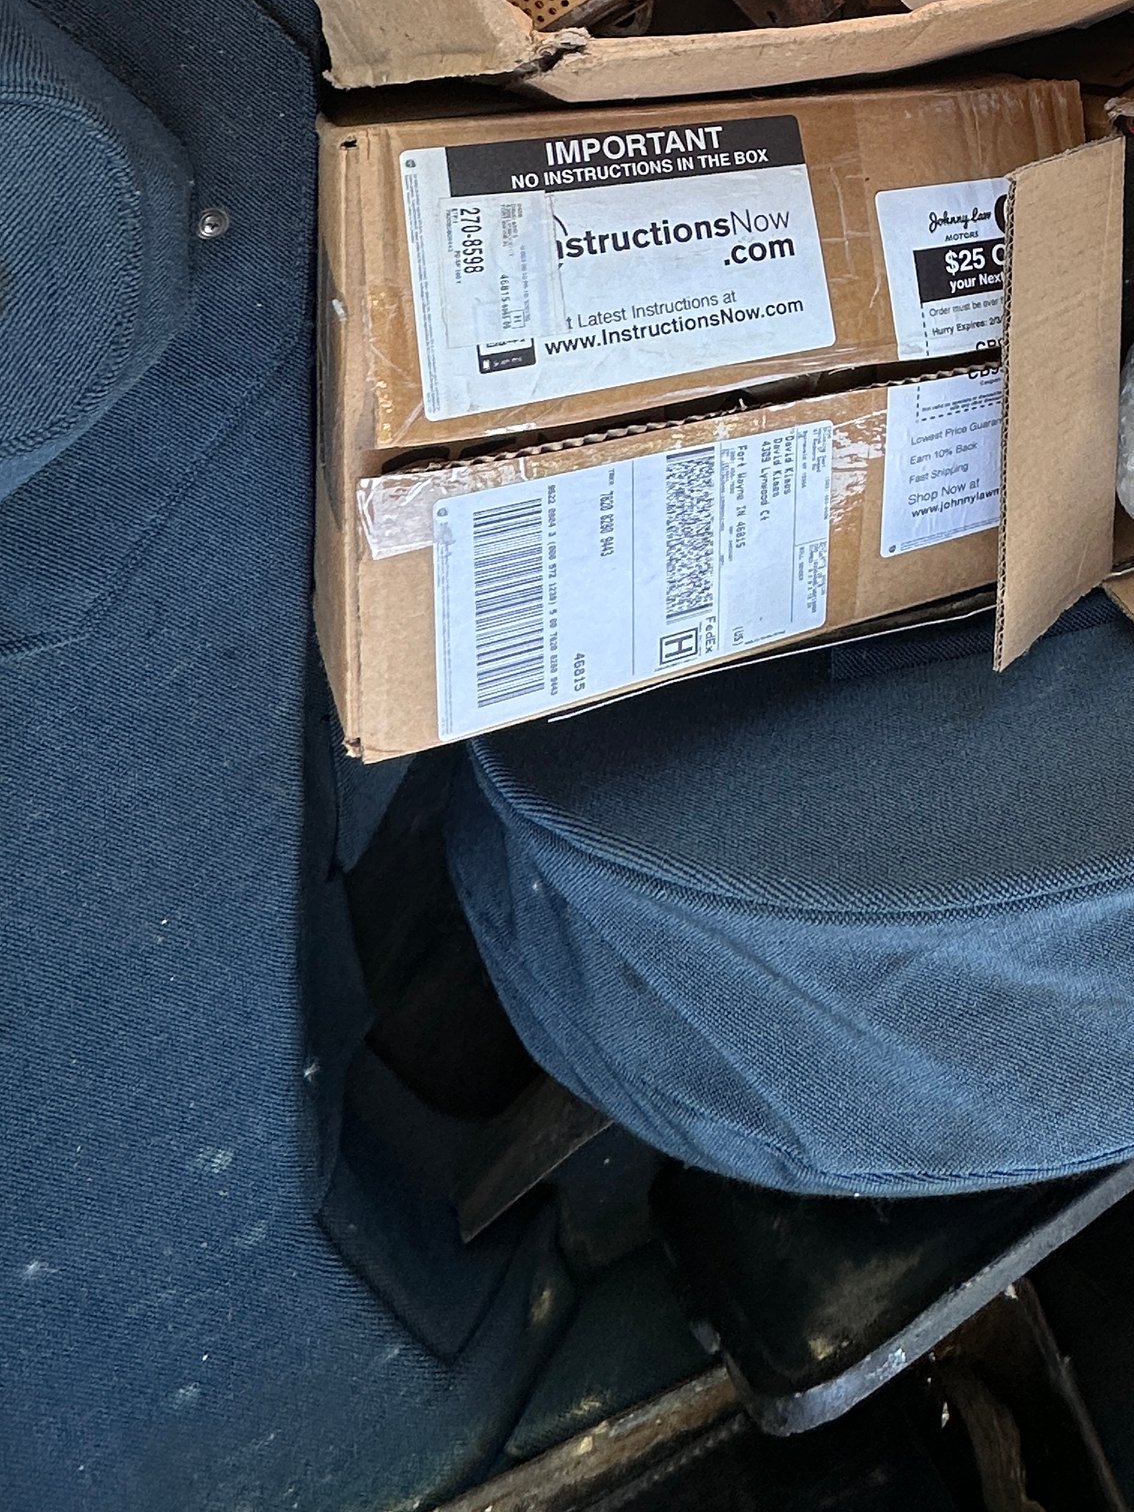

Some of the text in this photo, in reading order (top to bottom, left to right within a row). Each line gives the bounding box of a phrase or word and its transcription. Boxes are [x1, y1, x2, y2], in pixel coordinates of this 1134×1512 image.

[545, 125, 724, 167] IMPORTANT
[511, 148, 769, 190] NO INSTRUCTIONS IN THE BOX
[944, 230, 979, 242] MOTORS
[723, 237, 796, 266] .com
[945, 247, 986, 276] $25
[949, 277, 977, 294] your
[577, 307, 628, 329] Latest
[631, 293, 720, 319] Instructions
[722, 290, 737, 304] at
[929, 306, 951, 317] Order
[971, 300, 981, 310] be
[544, 299, 805, 356] www.InstructionsNow.com
[932, 325, 955, 337] Hurry
[910, 430, 944, 446] Lowest
[944, 425, 968, 438] Price
[737, 444, 748, 468] Fort
[910, 441, 979, 466] Earn 10% Back
[736, 472, 747, 501] Wayne
[908, 462, 969, 485] Fast Shipping
[907, 477, 981, 506] Shop Now at
[736, 505, 747, 517] IN
[664, 634, 694, 659] H
[704, 615, 716, 654] FedEx
[573, 652, 586, 692] 46815
